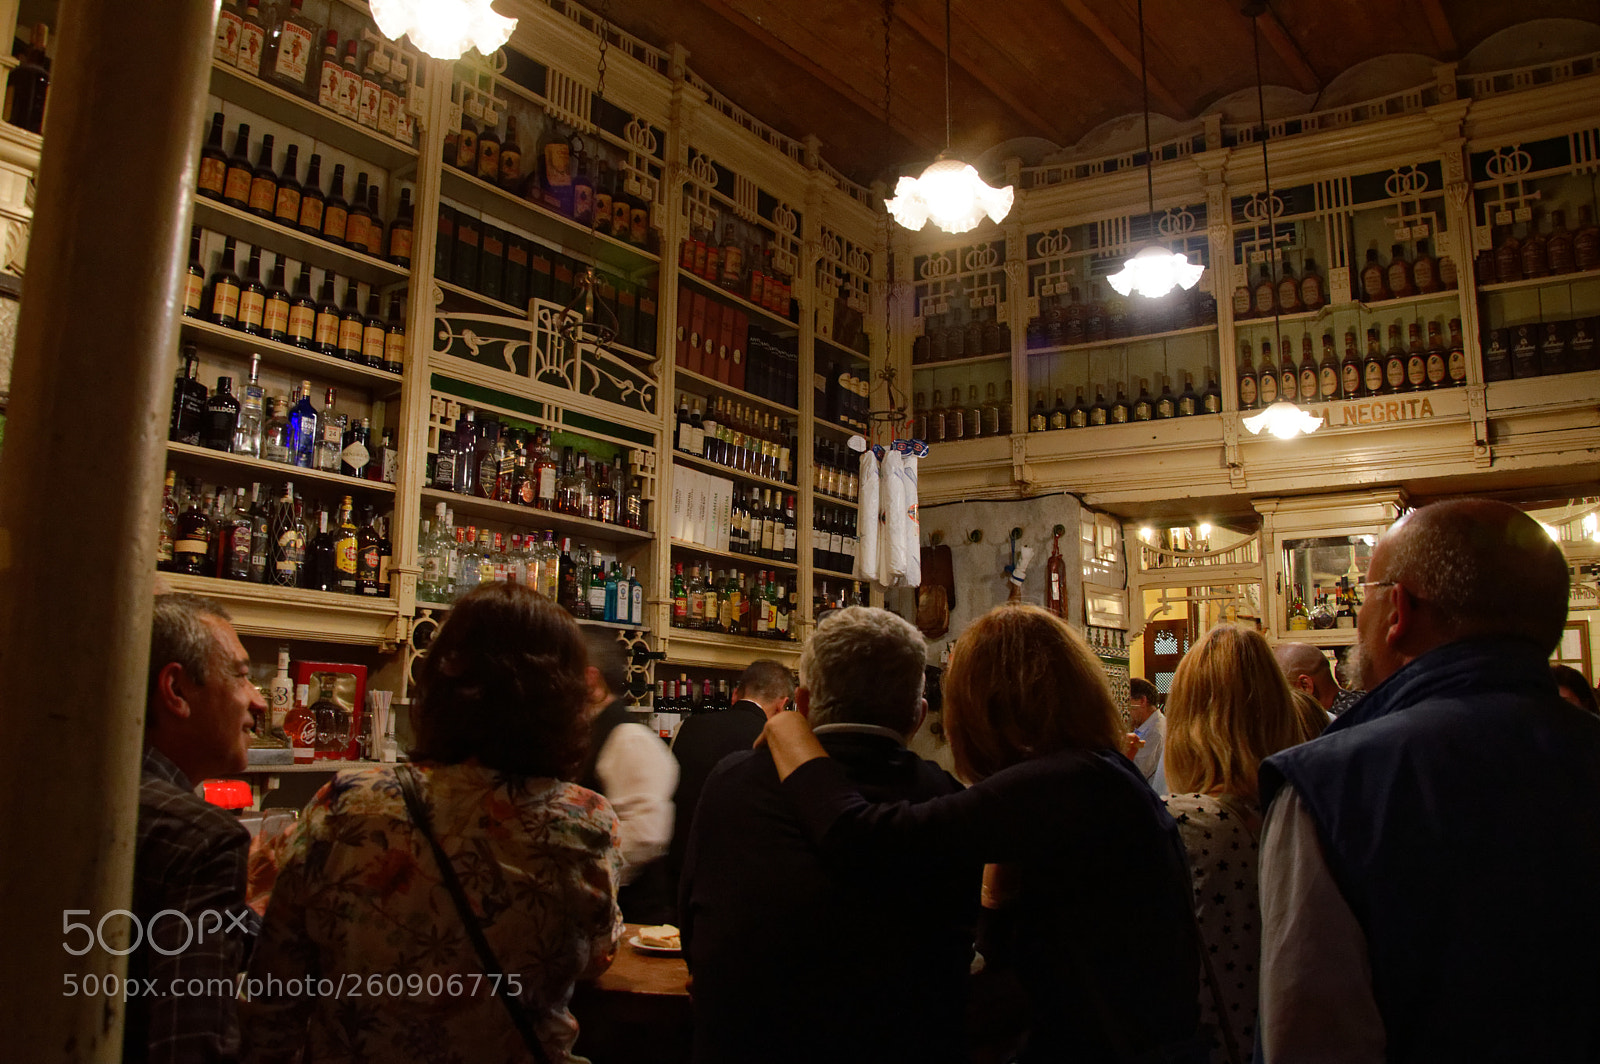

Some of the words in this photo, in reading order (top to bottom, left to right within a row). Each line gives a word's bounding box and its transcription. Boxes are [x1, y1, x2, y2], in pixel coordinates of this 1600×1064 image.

[286, 23, 312, 41] BEEFEATER
[1343, 396, 1434, 425] NEGRITA
[328, 430, 337, 438] 24
[274, 686, 288, 706] 3
